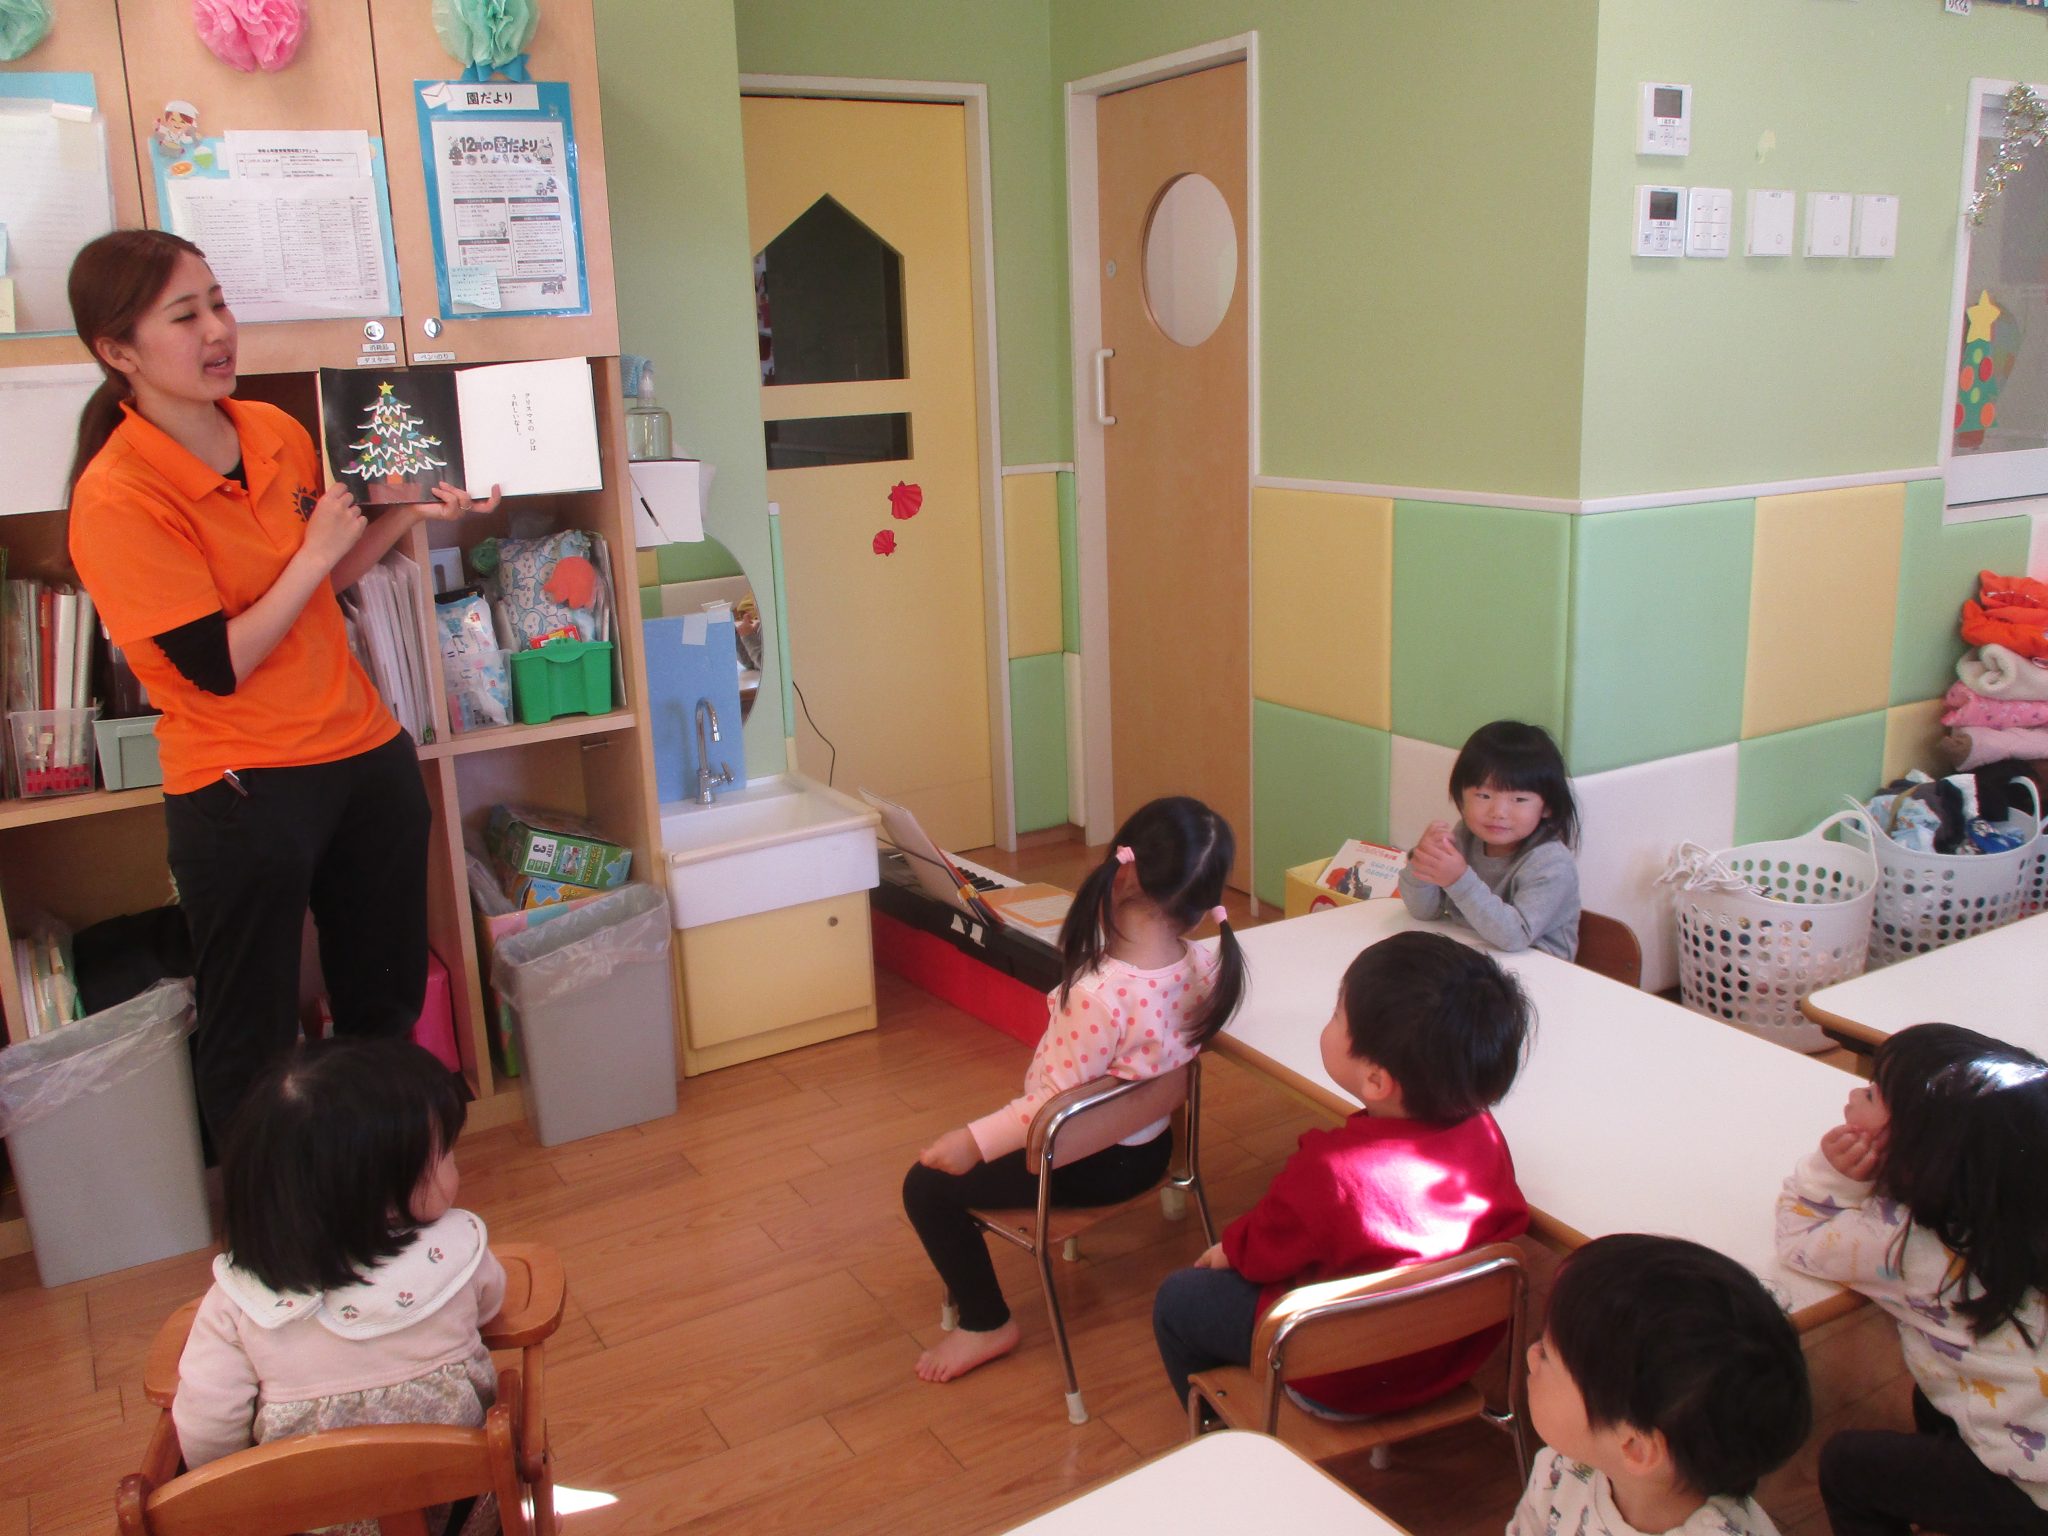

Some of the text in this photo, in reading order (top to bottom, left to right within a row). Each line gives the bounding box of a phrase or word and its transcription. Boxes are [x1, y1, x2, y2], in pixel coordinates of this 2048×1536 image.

[466, 91, 513, 105] 園だより
[459, 136, 538, 153] 12月の園だより
[532, 844, 547, 854] 3
[547, 844, 555, 857] STEP
